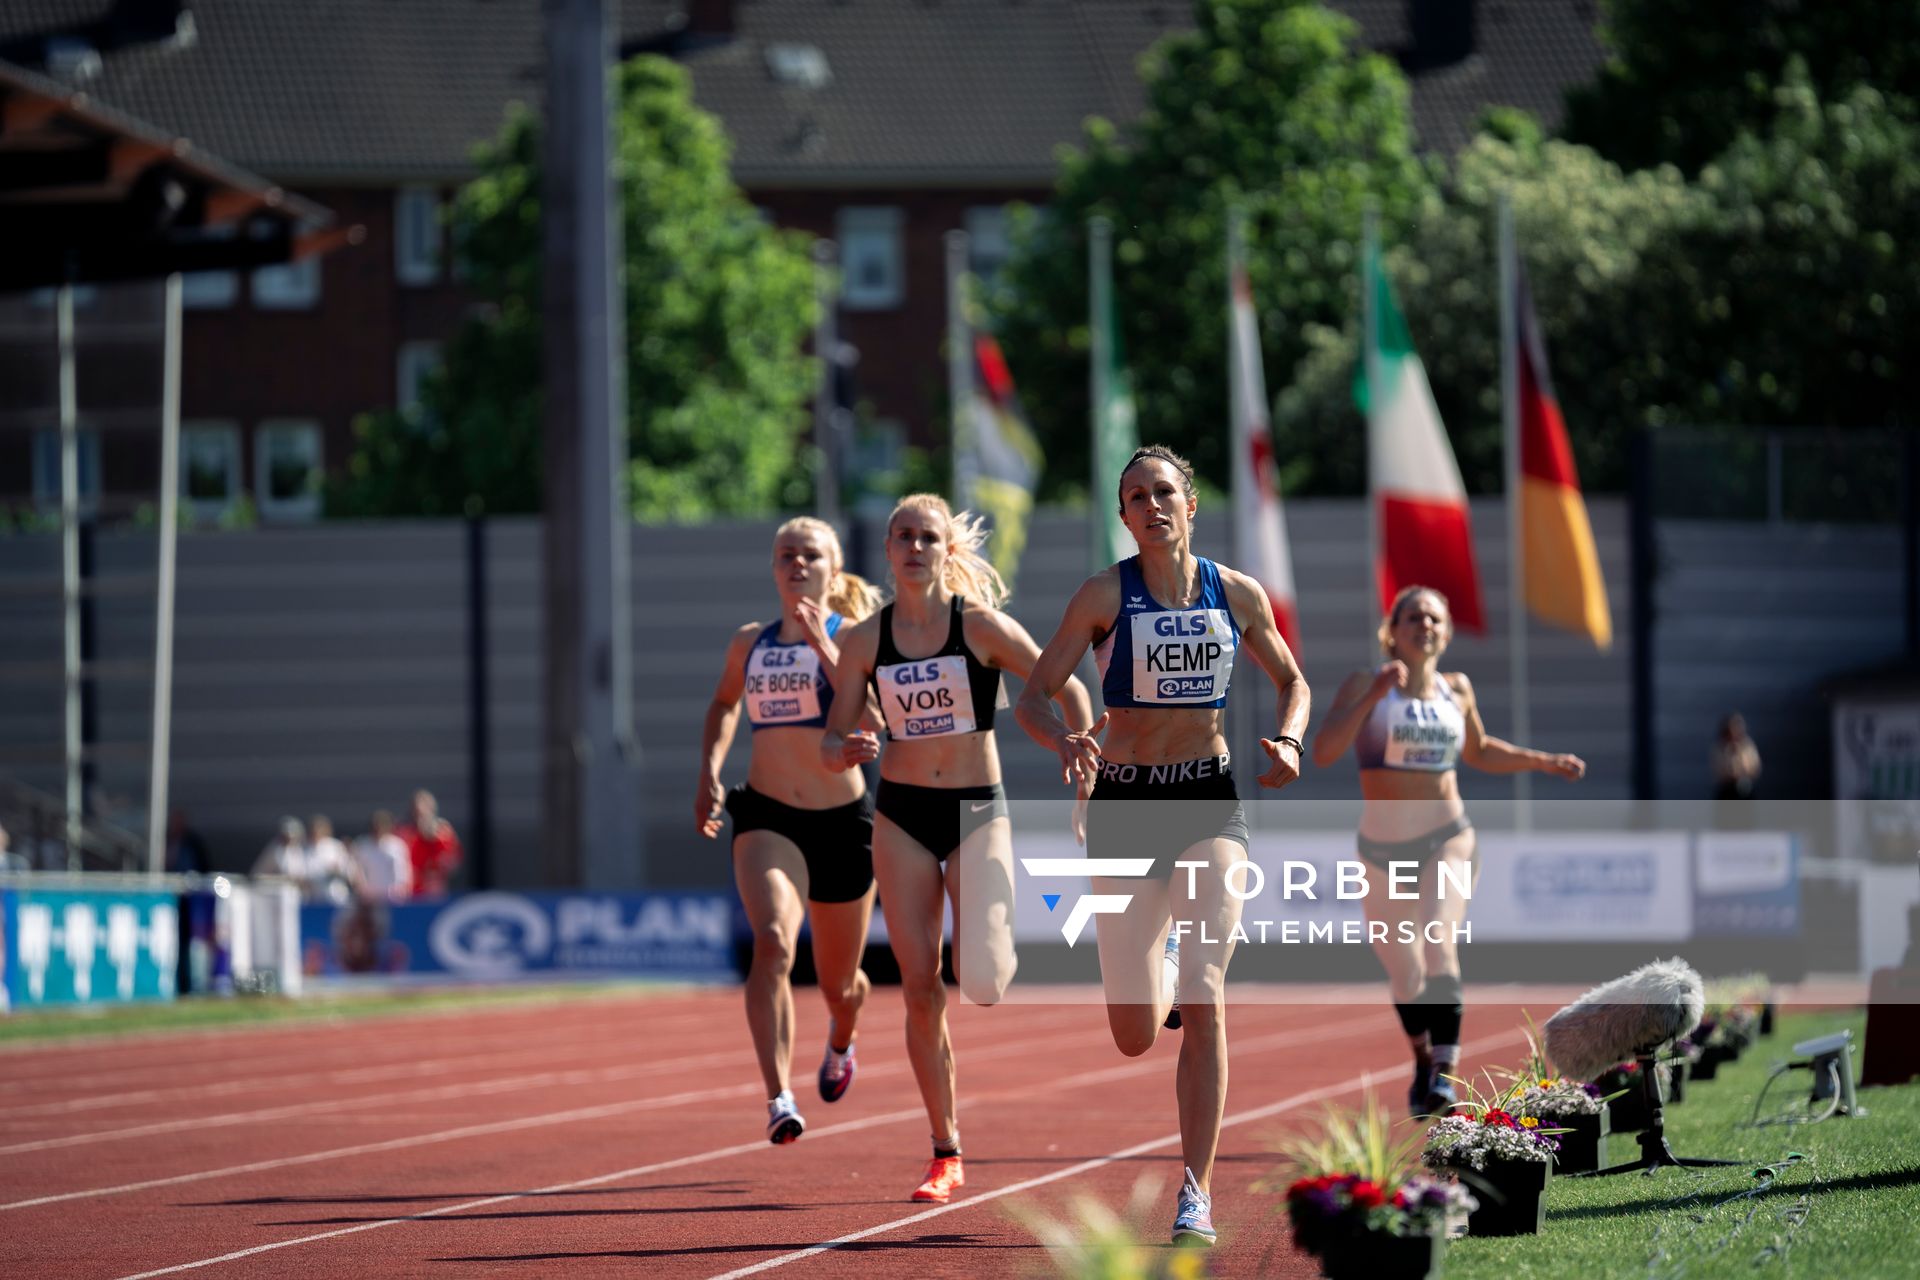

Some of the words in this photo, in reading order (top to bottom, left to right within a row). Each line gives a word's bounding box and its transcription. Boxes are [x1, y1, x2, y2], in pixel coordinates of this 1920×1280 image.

[1146, 642, 1221, 672] KEMP
[747, 675, 764, 694] DE
[768, 672, 811, 693] BOER
[1181, 680, 1212, 690] PLAN
[923, 716, 952, 728] PLAN
[1096, 759, 1137, 783] PRO
[1148, 757, 1212, 785] NIKE
[555, 897, 731, 943] PLAN
